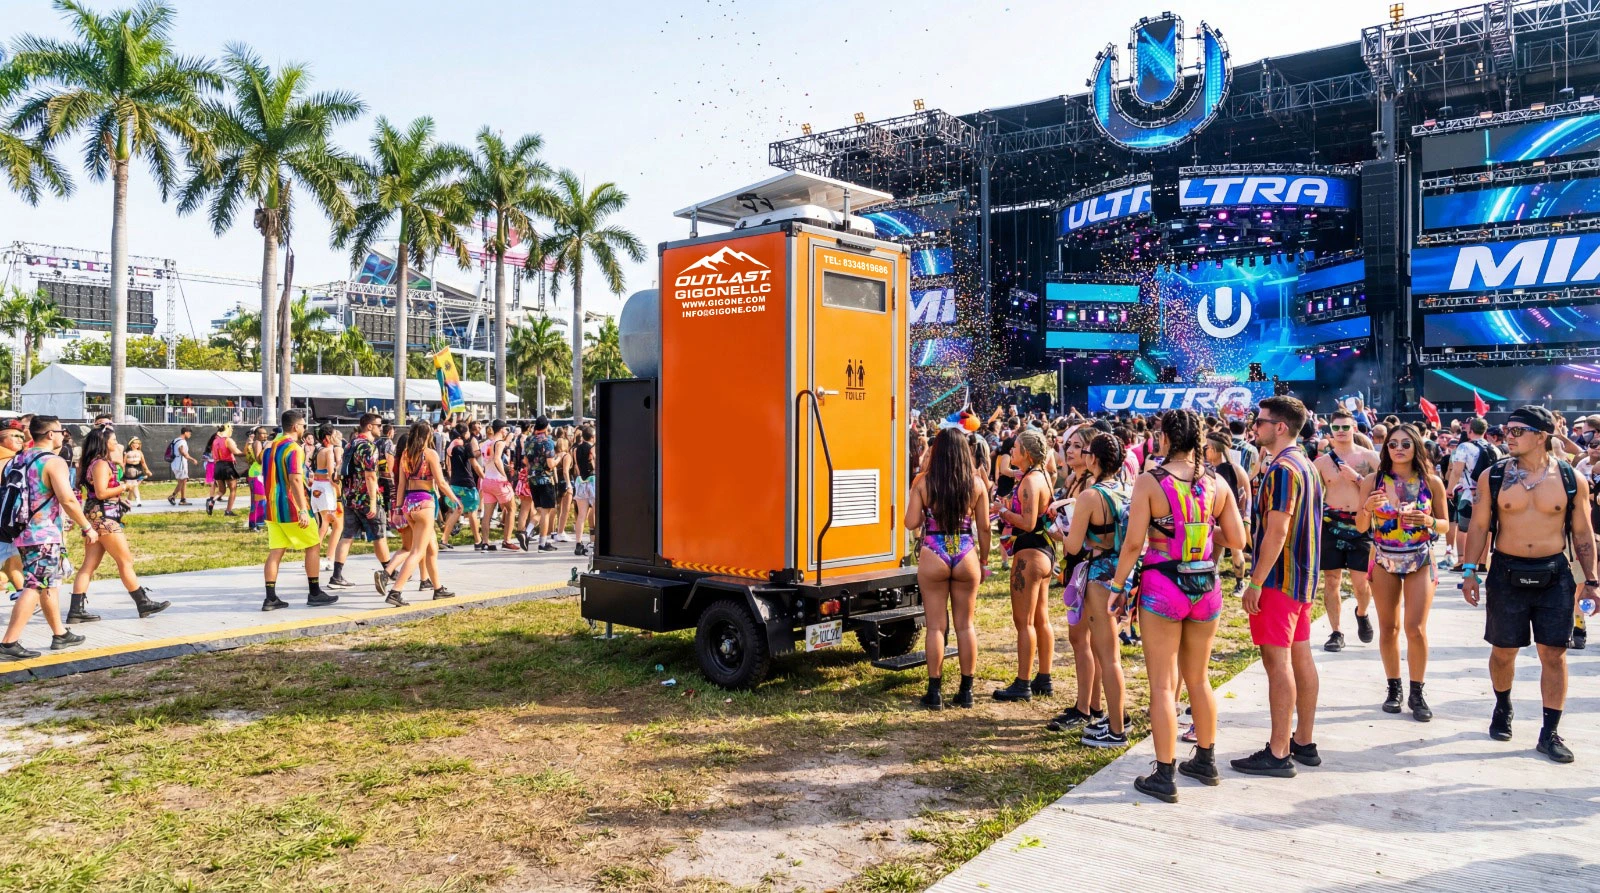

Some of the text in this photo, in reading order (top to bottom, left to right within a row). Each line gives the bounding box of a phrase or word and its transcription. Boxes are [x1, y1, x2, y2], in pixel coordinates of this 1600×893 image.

[823, 254, 889, 274] TEL: 8334819686
[674, 269, 772, 287] OUTLAST
[674, 283, 772, 300] GIGONELLC
[681, 295, 766, 309] WWW.GIGONE.COM
[681, 305, 766, 318] INFO@GIGONE.COM
[1104, 387, 1252, 410] ULTRA
